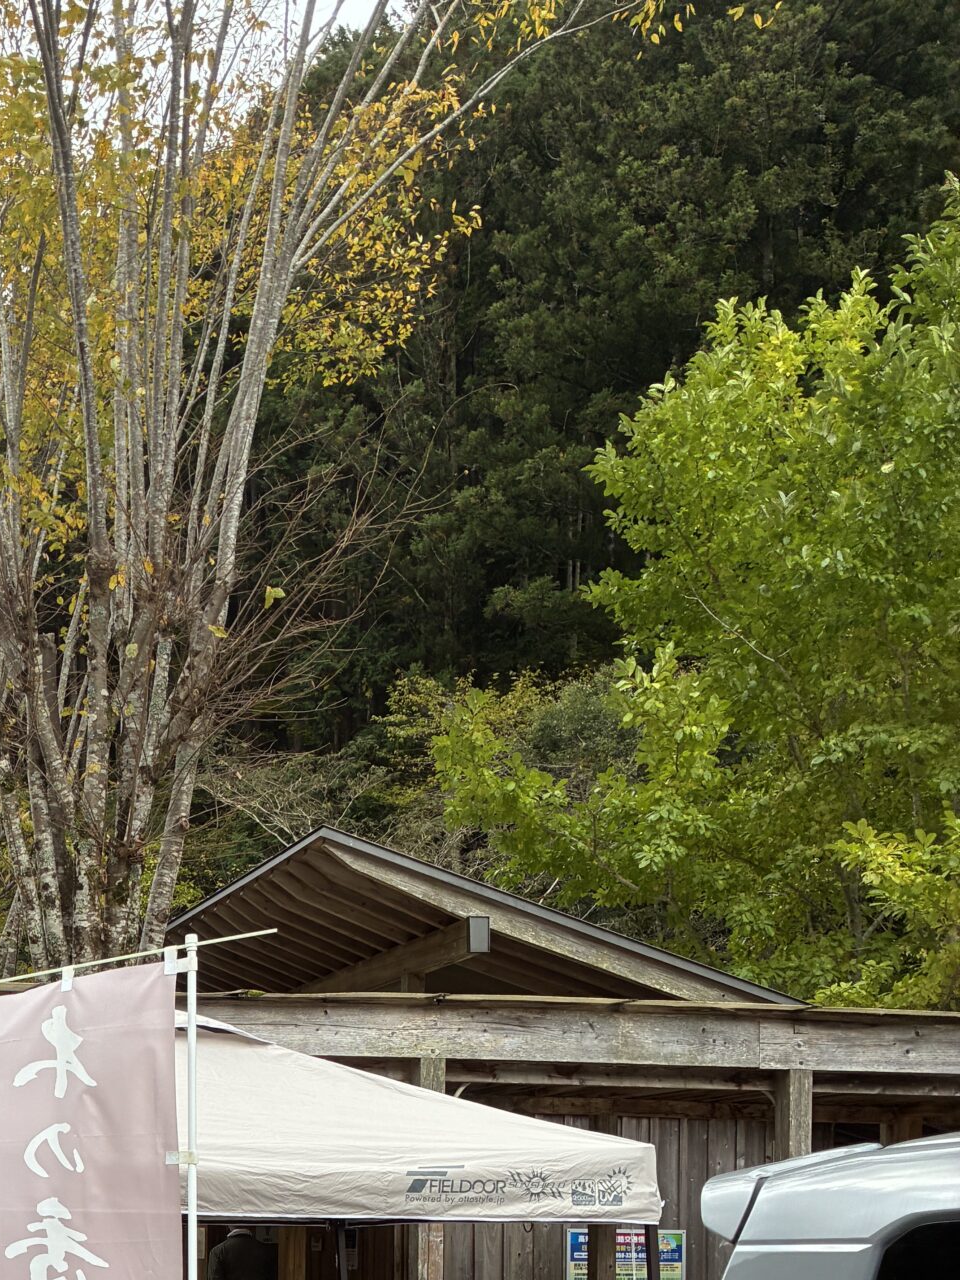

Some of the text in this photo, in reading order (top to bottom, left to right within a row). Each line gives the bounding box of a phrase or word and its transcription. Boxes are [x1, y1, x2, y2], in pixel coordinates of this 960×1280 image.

[429, 1179, 507, 1195] FIELDOOR
[405, 1194, 442, 1203] Powered
[445, 1194, 456, 1205] by
